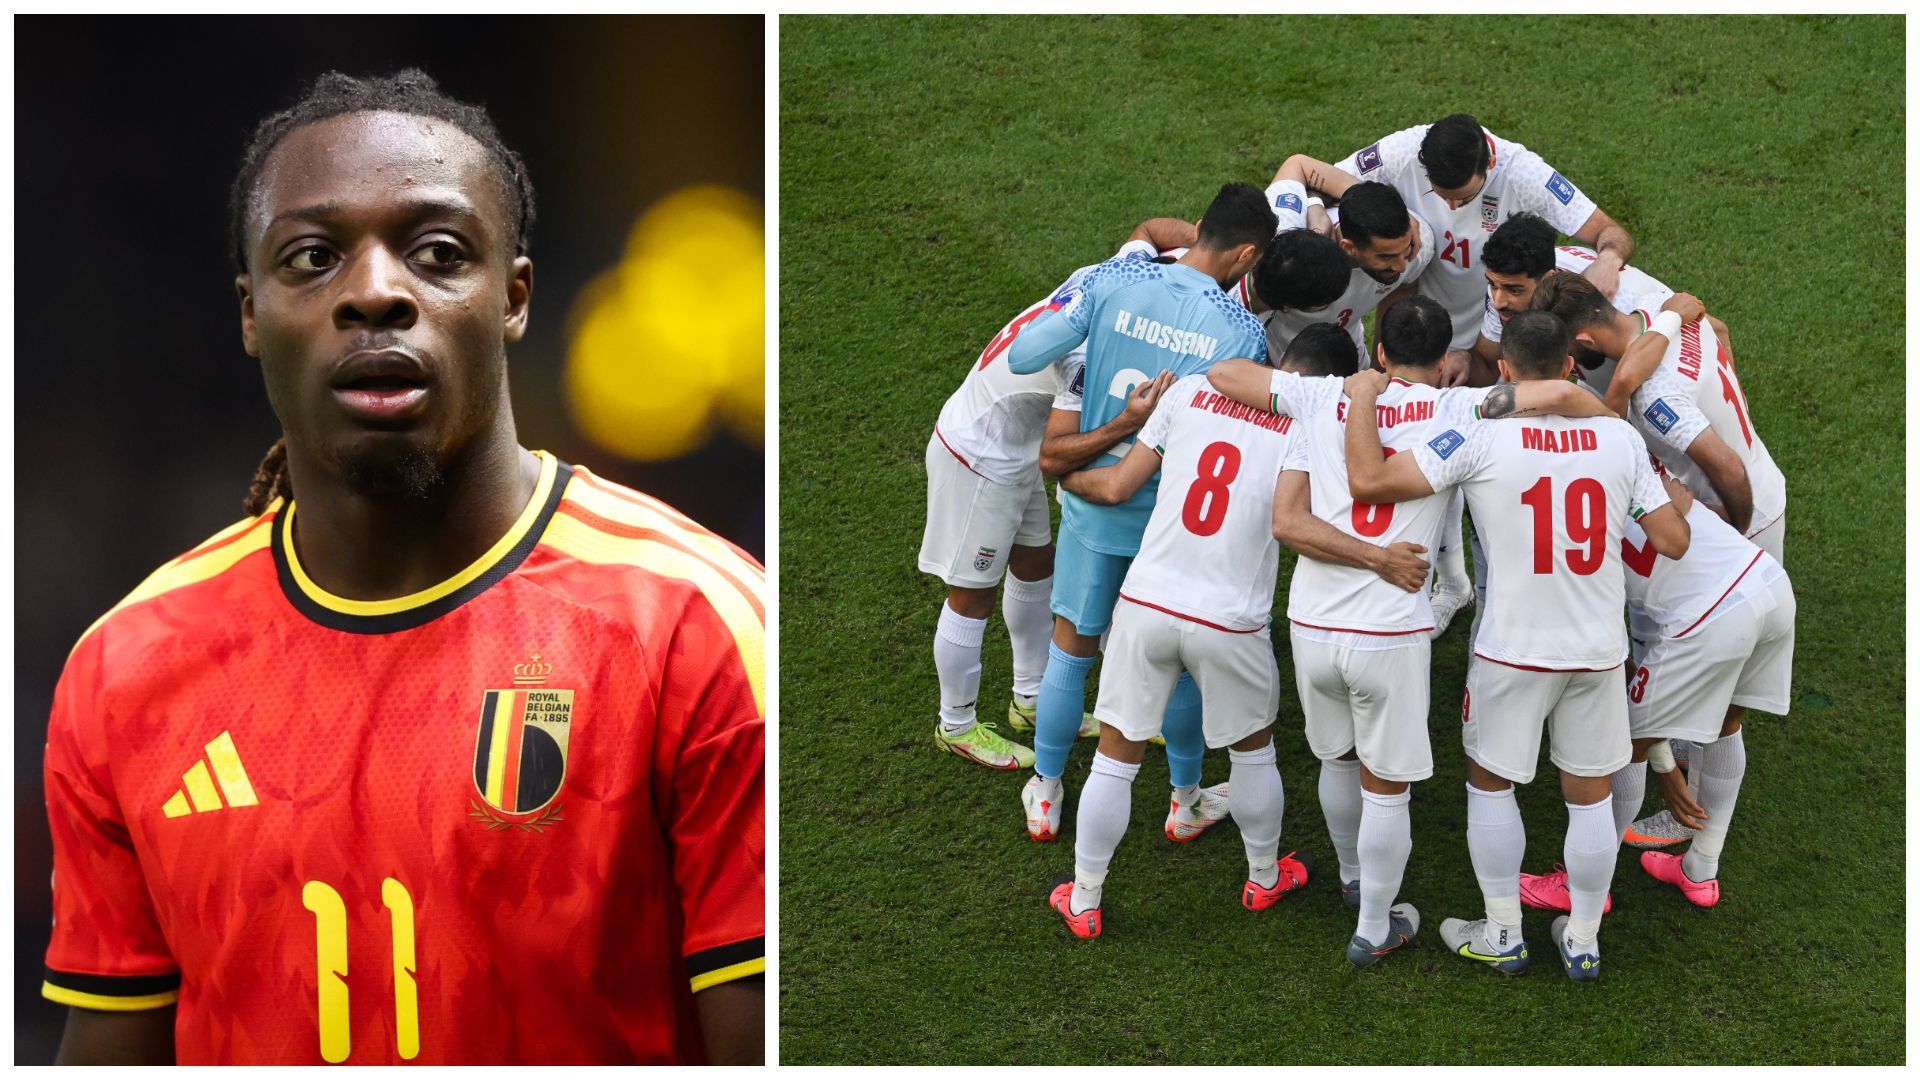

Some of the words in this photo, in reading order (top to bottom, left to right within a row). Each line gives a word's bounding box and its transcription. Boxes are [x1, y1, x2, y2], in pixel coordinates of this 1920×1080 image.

[1440, 230, 1470, 269] 21
[1521, 427, 1598, 453] MAJID
[1181, 440, 1242, 537] 8
[1520, 476, 1607, 576] 19
[526, 702, 571, 713] BELGIAN
[528, 692, 560, 702] ROYAL
[525, 712, 538, 721] FA
[543, 713, 569, 722] 1895
[302, 877, 420, 1064] 11
